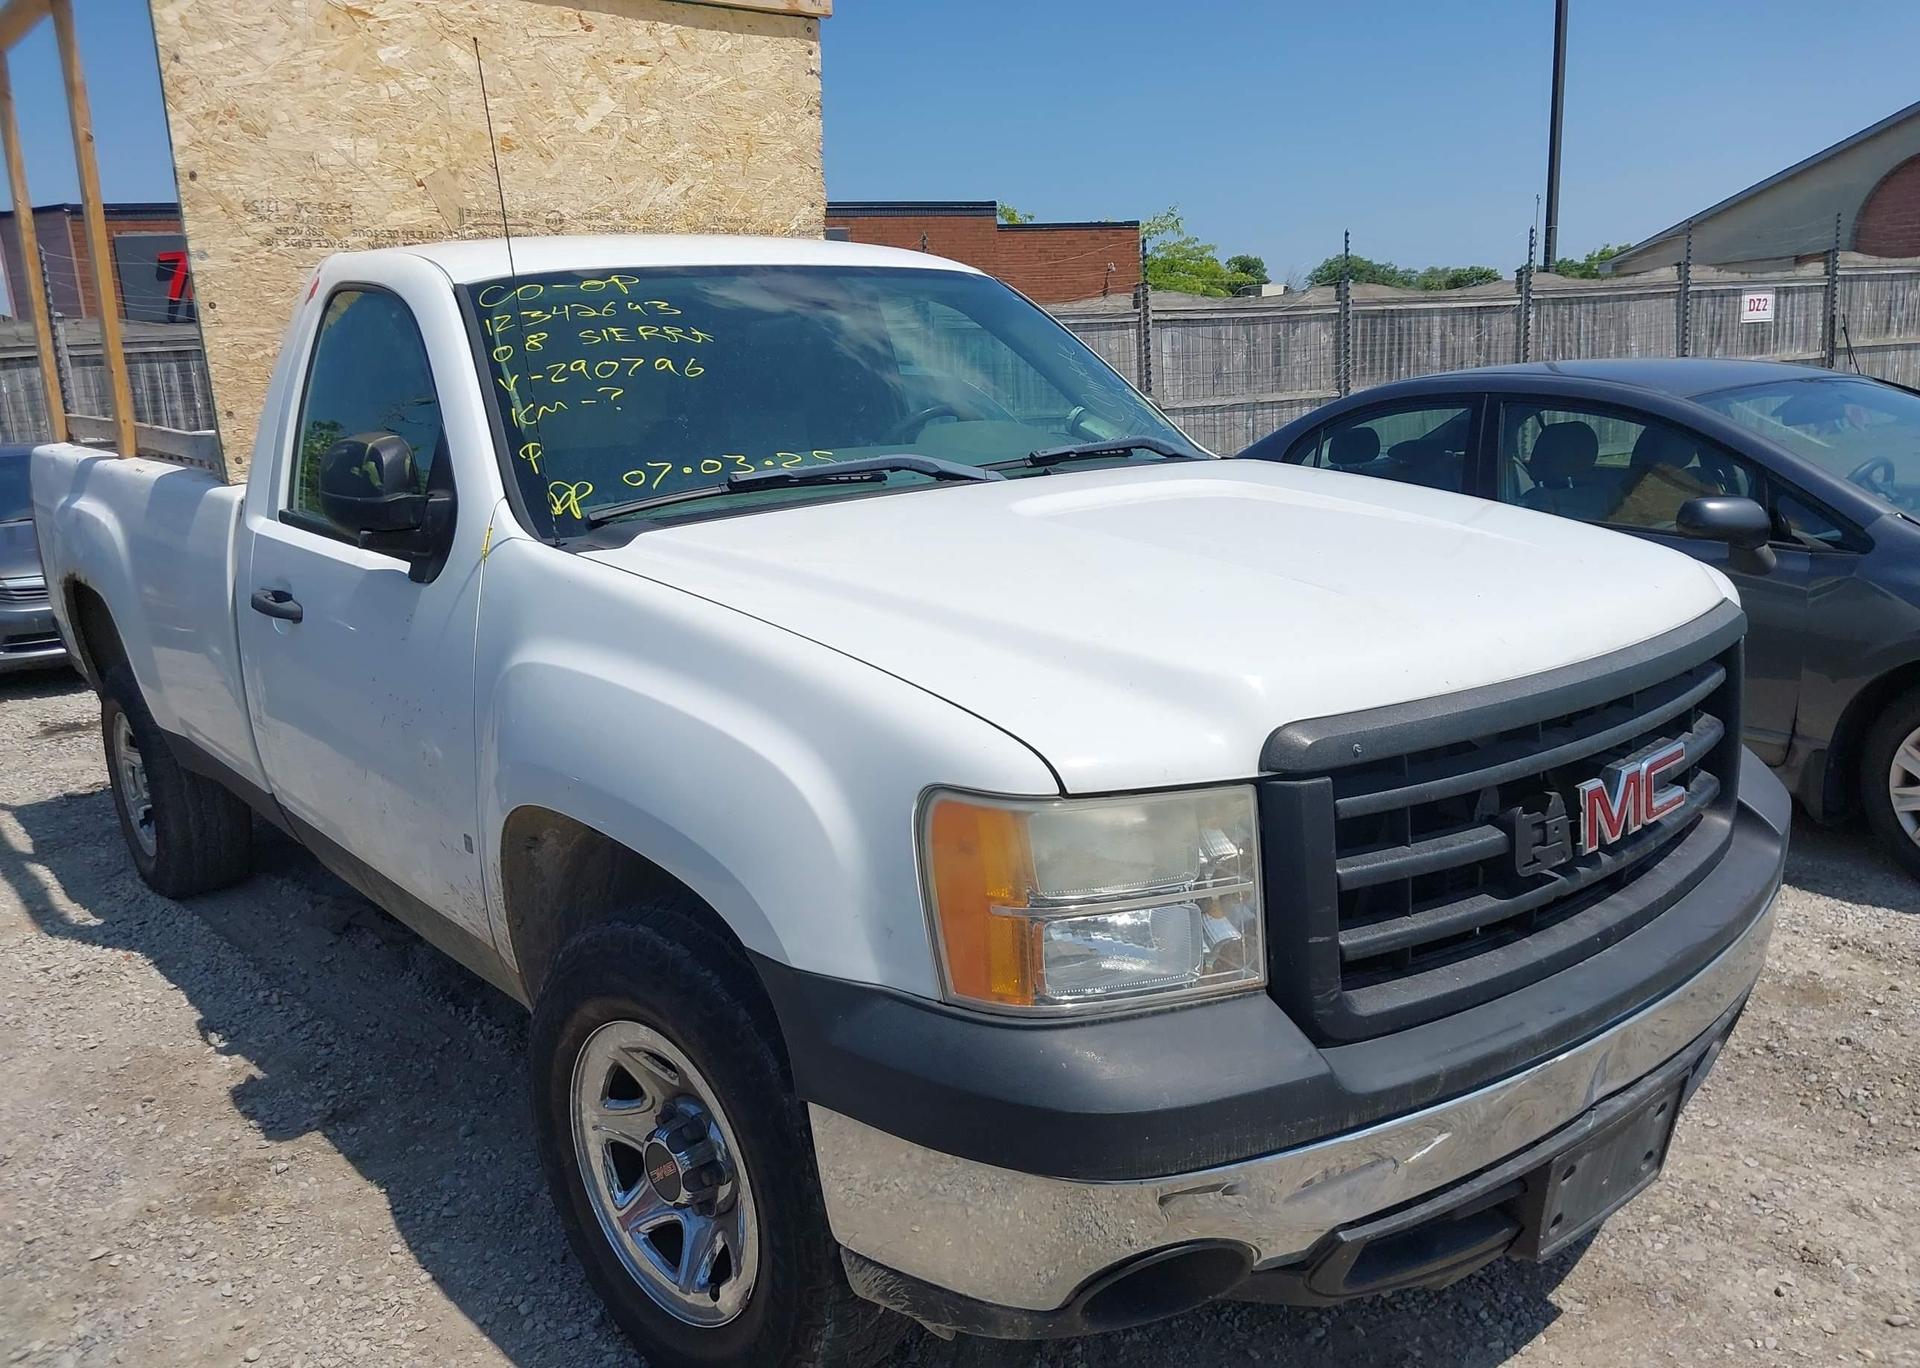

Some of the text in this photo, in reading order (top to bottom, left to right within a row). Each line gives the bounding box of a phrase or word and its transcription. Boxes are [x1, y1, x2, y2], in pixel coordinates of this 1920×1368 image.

[1748, 298, 1768, 312] DZ2
[579, 325, 714, 345] SIERRA
[1576, 742, 1687, 856] MC
[650, 1160, 677, 1183] GMC
